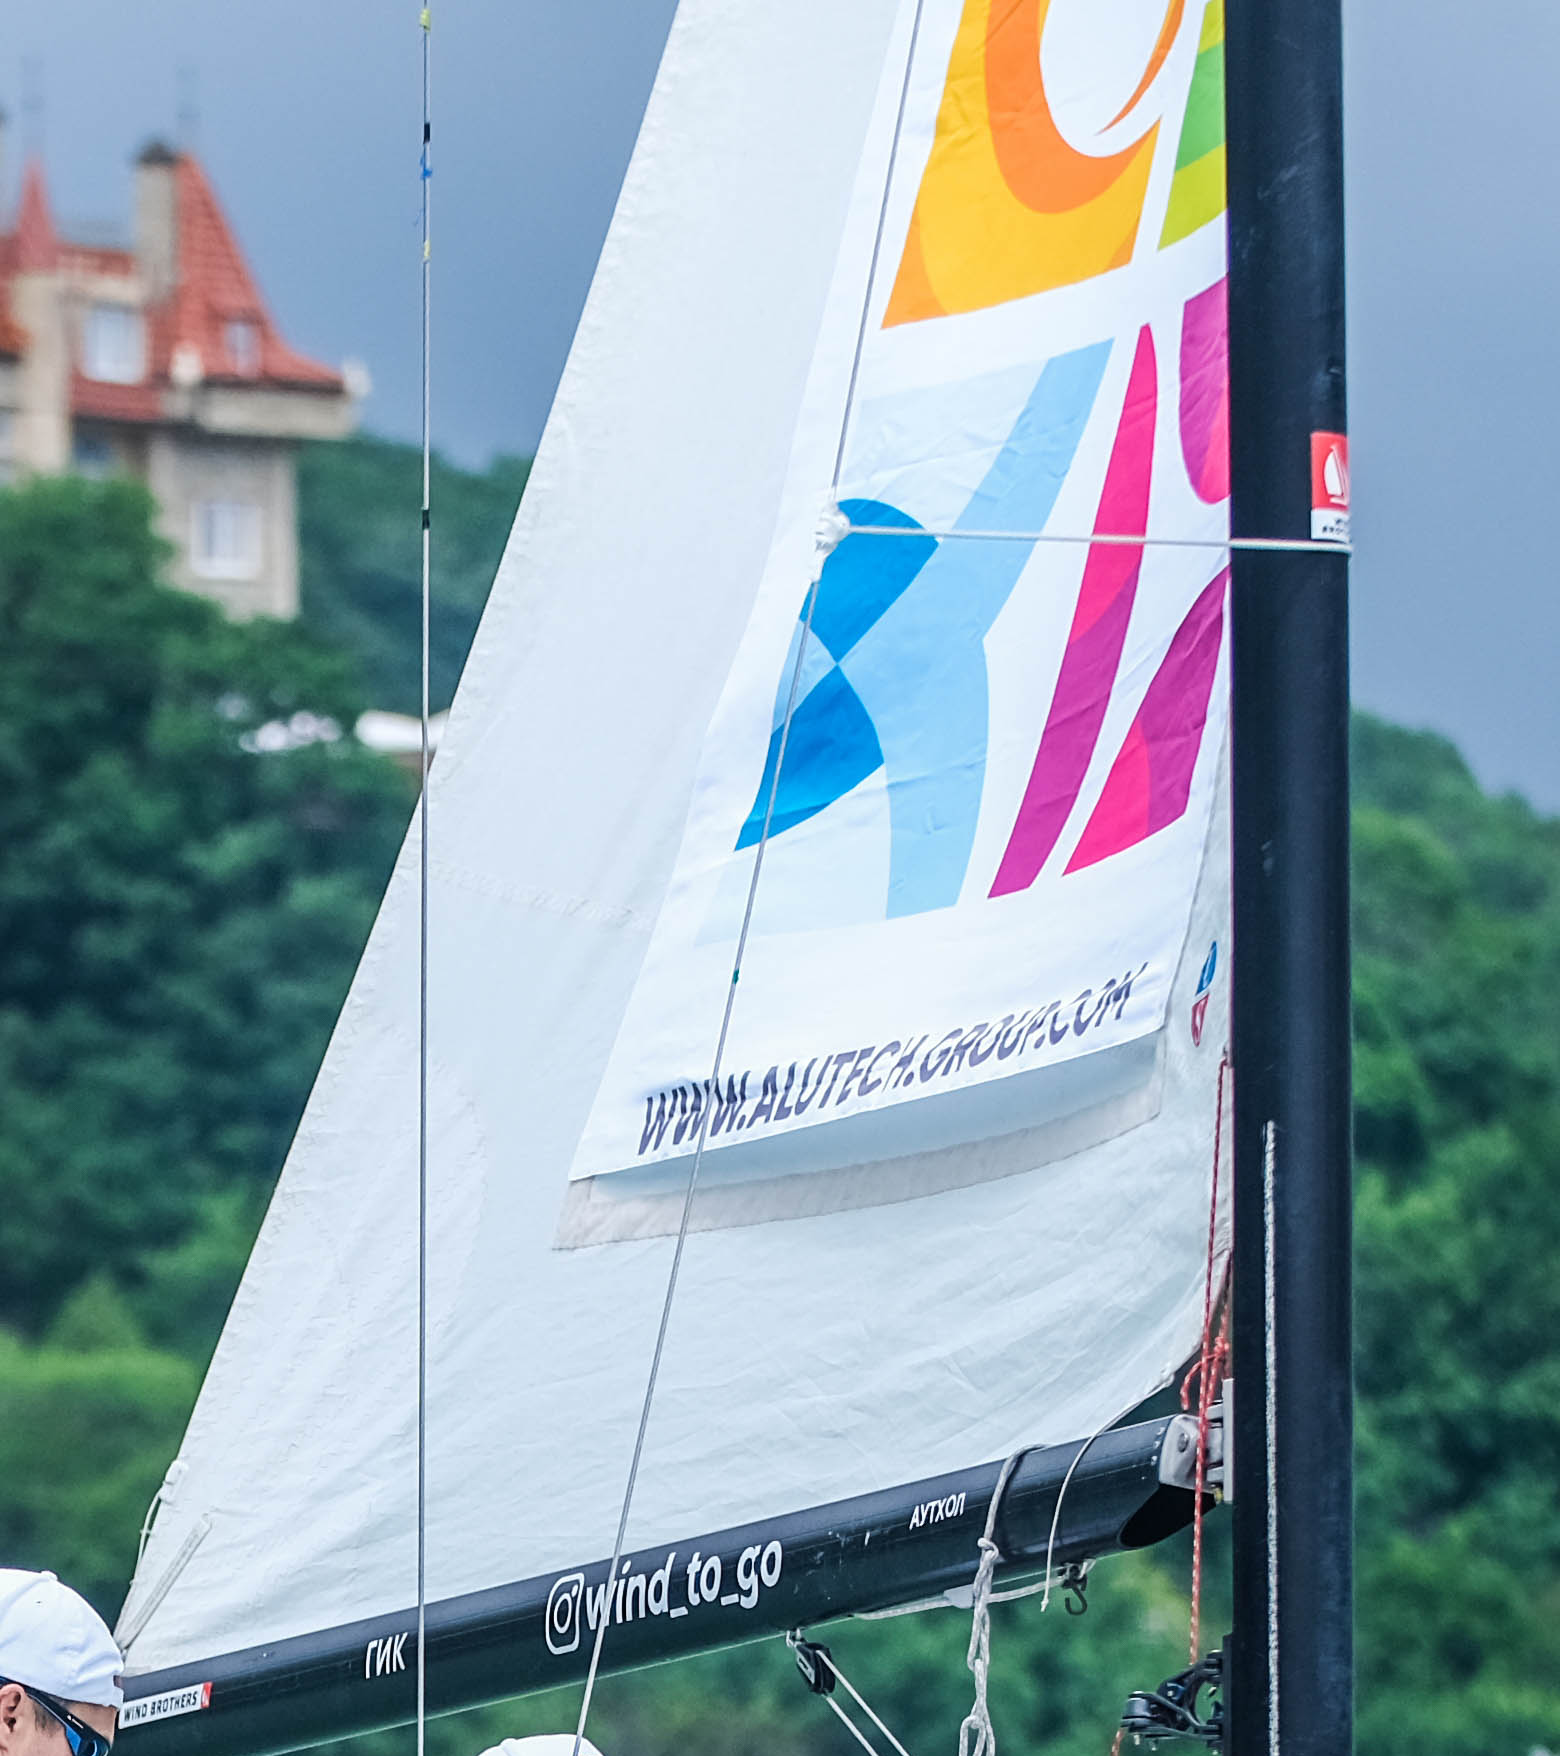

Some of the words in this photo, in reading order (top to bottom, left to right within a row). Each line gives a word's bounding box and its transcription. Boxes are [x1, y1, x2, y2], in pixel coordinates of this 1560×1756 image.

[909, 1492, 966, 1530] АУТХОЛ
[365, 1632, 408, 1679] ГИК
[124, 1704, 147, 1721] WIND
[151, 1691, 198, 1716] BROTHERS
